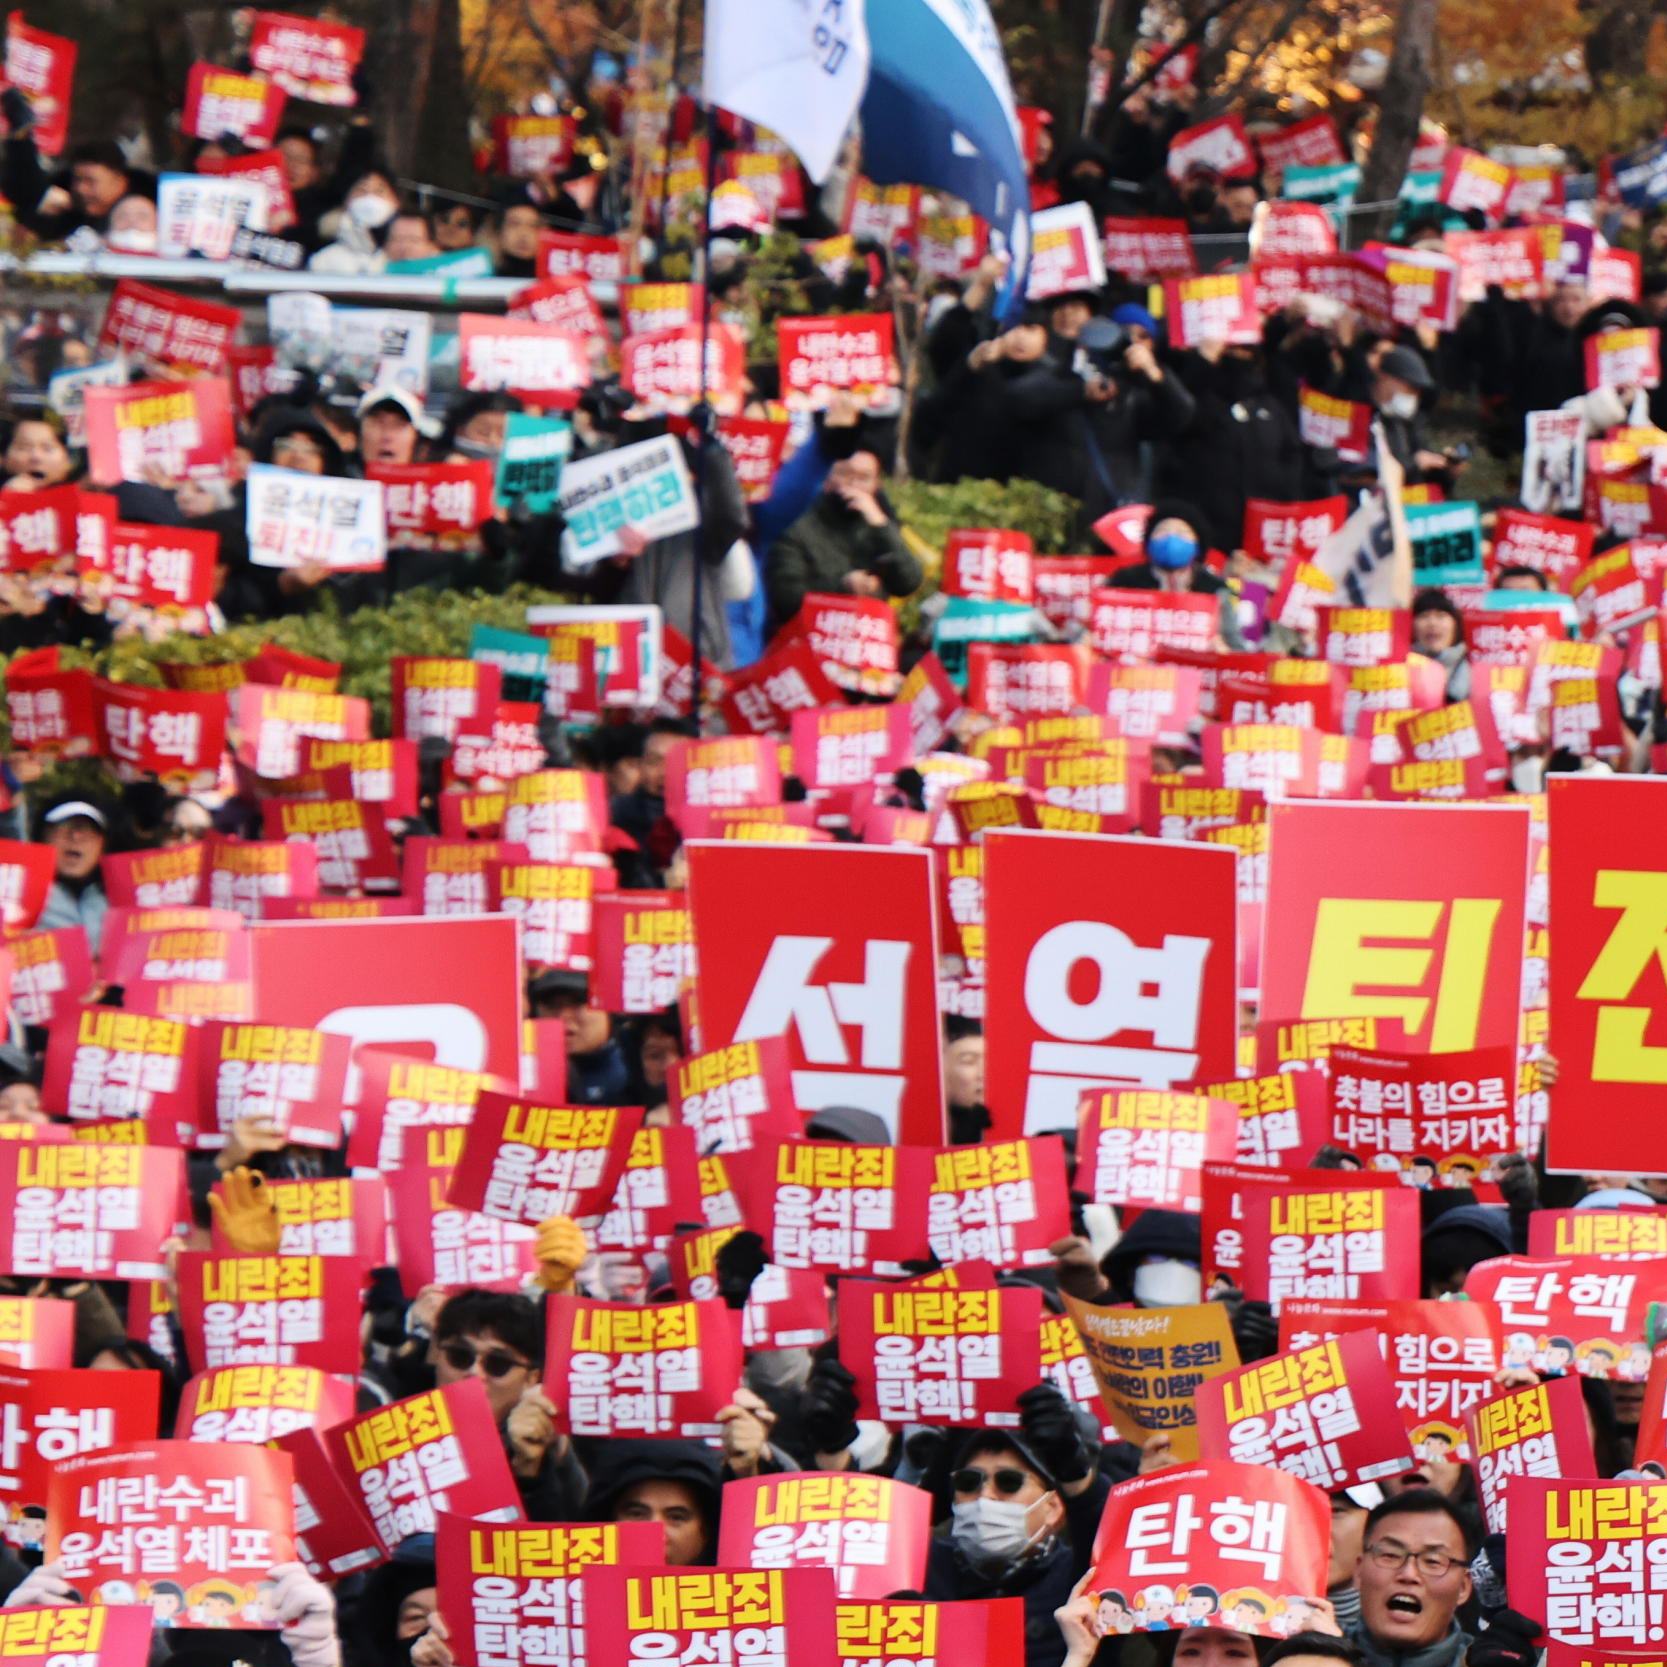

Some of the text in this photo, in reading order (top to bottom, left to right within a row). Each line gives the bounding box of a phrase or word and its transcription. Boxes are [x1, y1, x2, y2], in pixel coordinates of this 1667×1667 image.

[107, 705, 200, 764] 탄핵
[1335, 1076, 1505, 1114] 촛불의 힘으로
[1335, 1115, 1510, 1152] 나라를 지키자
[571, 1303, 698, 1350] 내란죄
[568, 1348, 701, 1397] 윤석열
[568, 1393, 672, 1436] 탄핵!
[79, 1478, 246, 1523] 내란수괴
[59, 1526, 272, 1578] 윤석열 체포
[1126, 1497, 1288, 1579] 탄핵
[1547, 1592, 1664, 1645] 탄핵!
